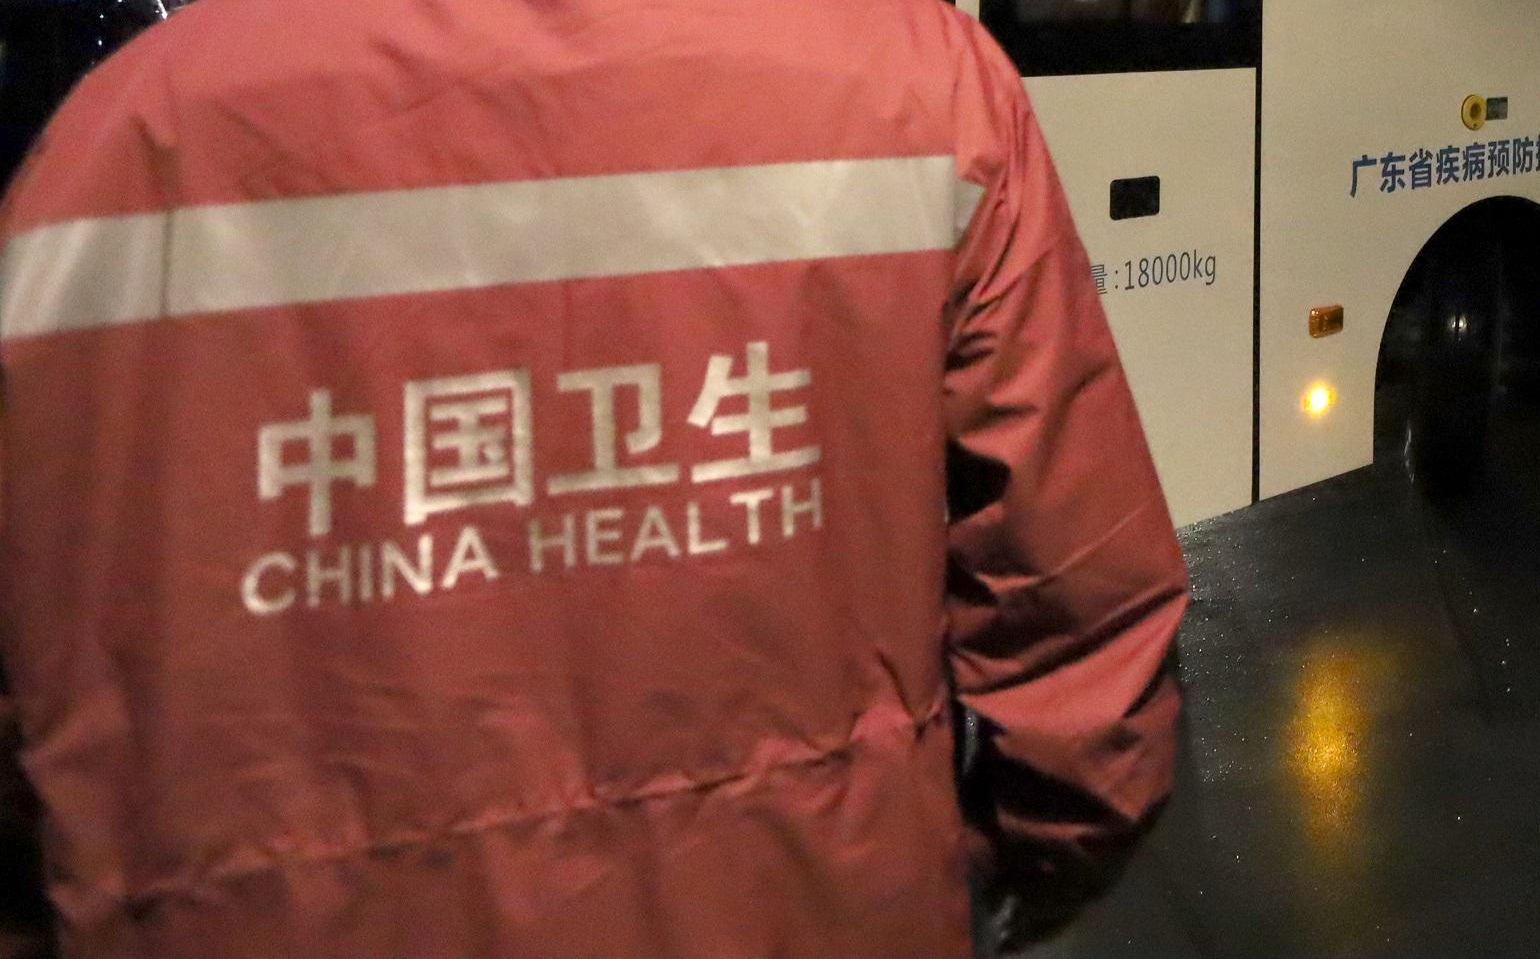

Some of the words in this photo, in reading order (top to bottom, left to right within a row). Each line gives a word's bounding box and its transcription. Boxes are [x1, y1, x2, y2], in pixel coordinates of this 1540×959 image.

[257, 340, 822, 536] 中国卫生
[241, 526, 500, 616] CHINA
[527, 477, 824, 574] HEALTH
